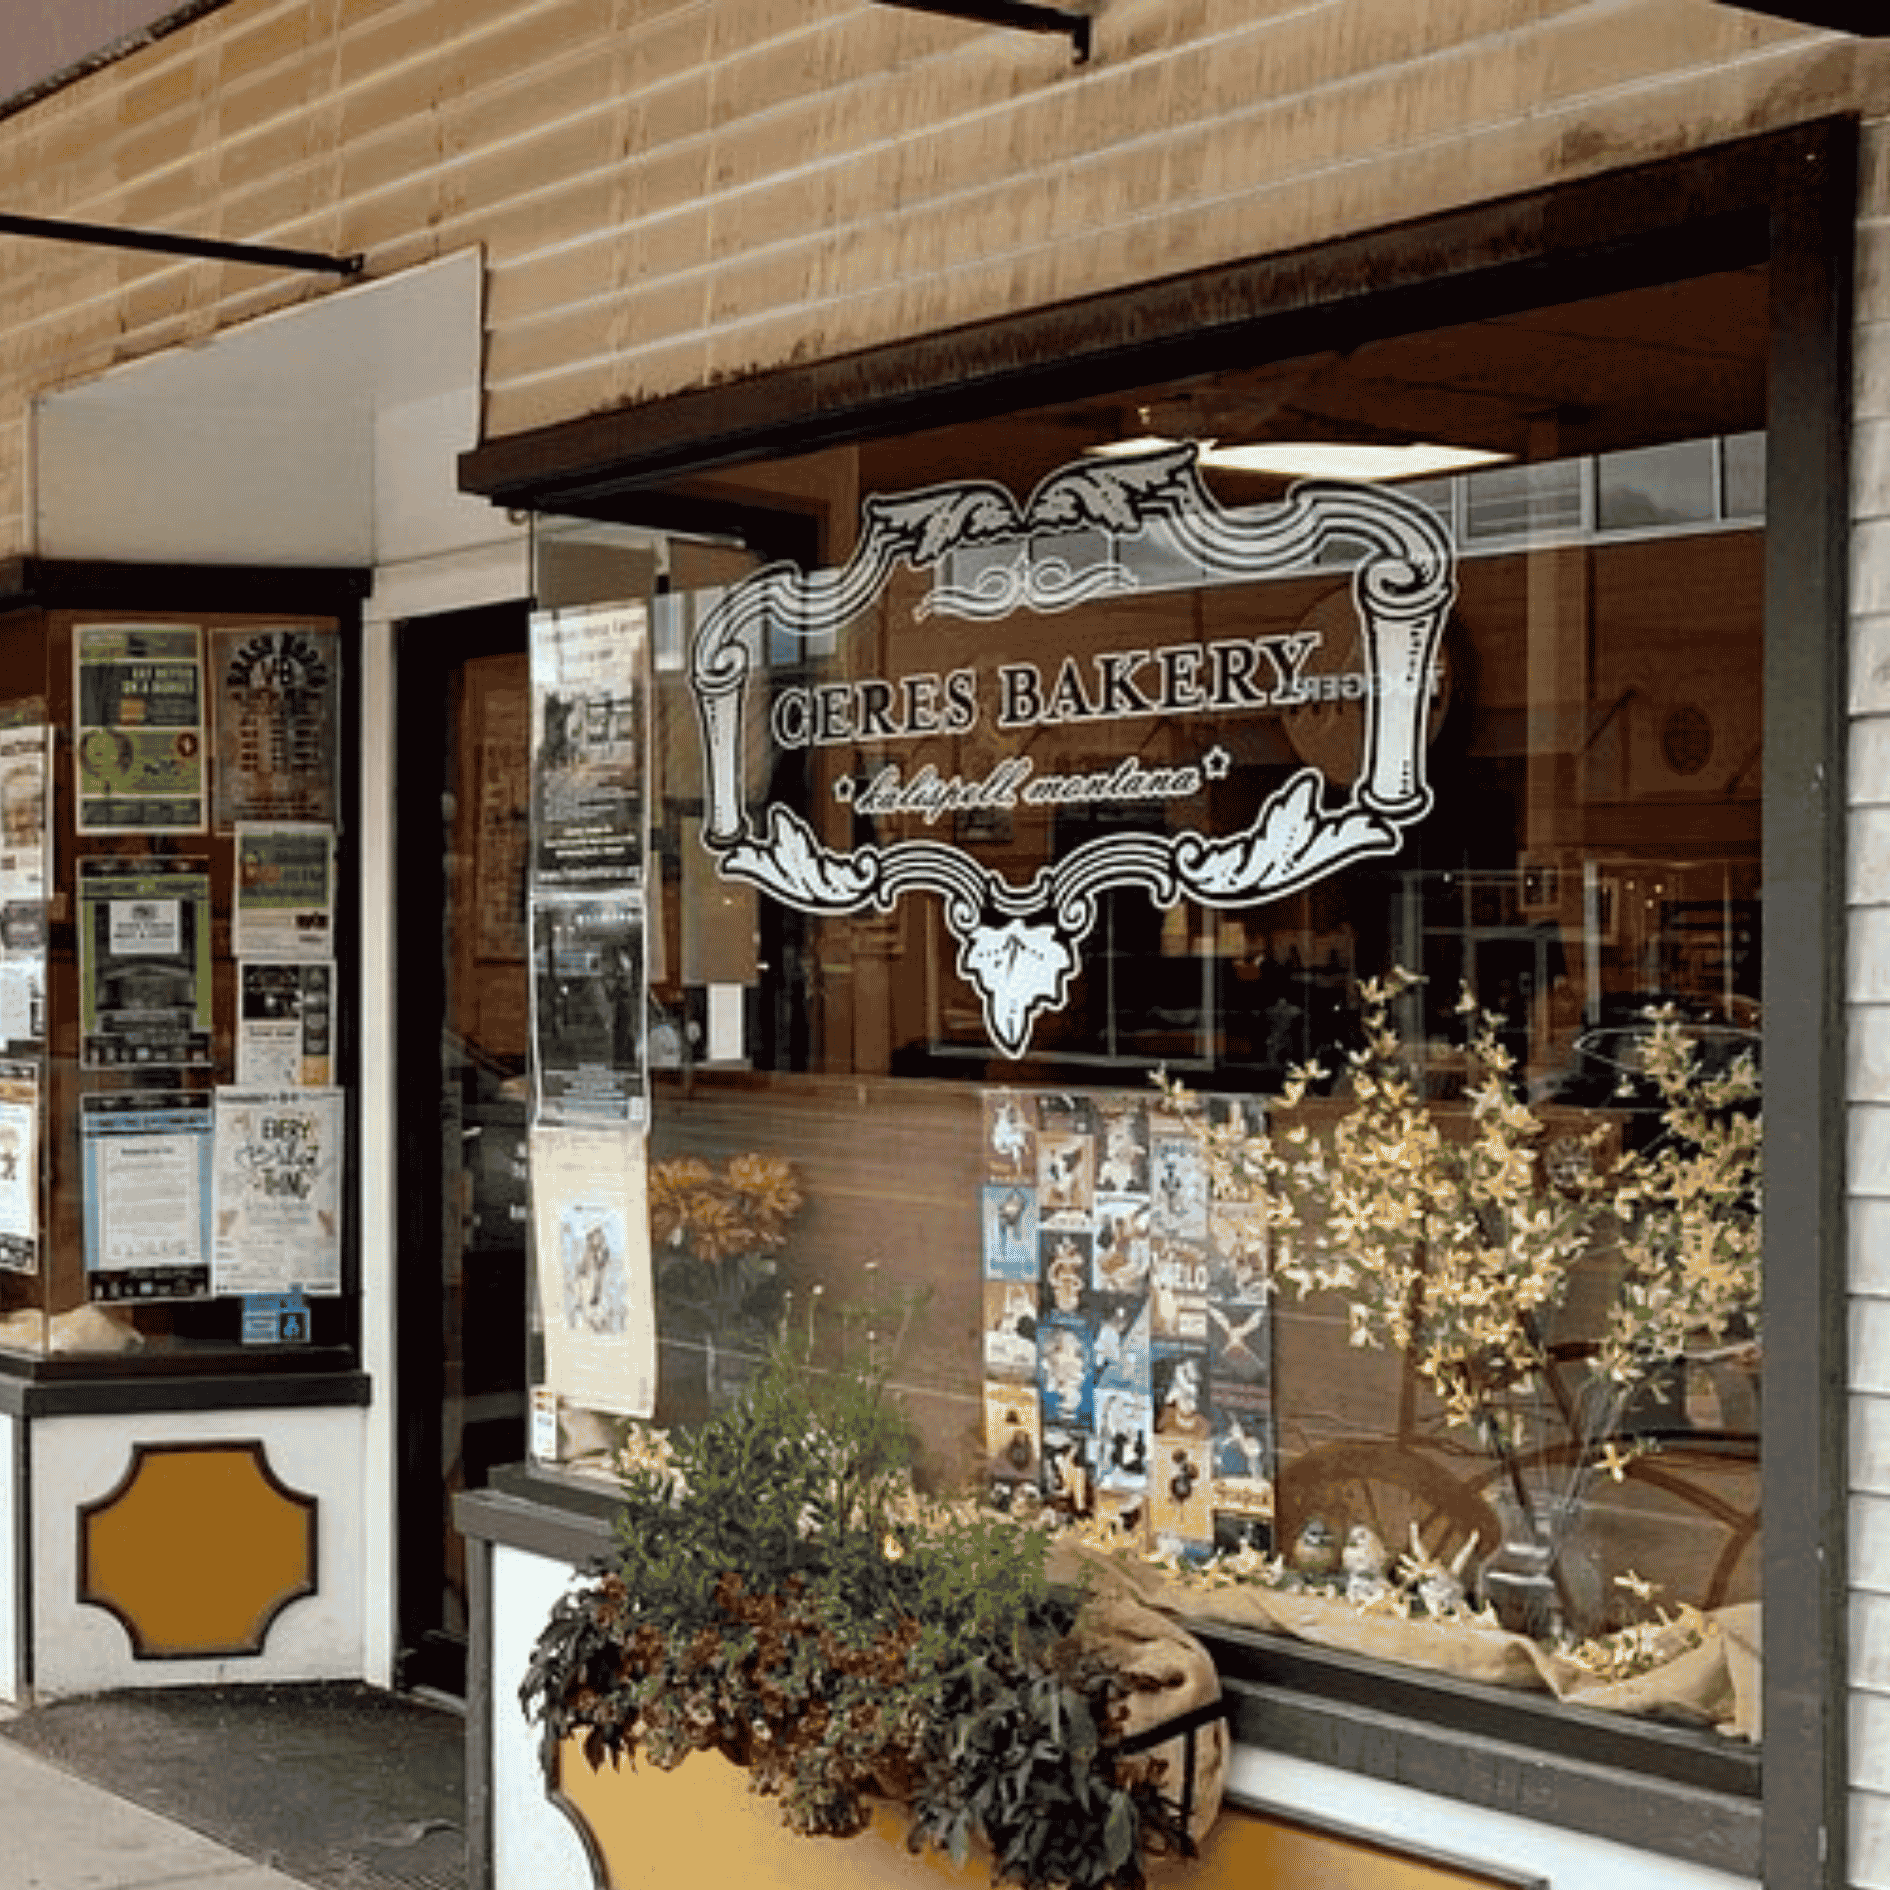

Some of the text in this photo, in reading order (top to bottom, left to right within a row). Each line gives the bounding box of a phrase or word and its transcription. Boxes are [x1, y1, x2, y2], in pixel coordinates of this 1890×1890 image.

[771, 631, 1323, 749] CERES BAKERY
[854, 755, 1201, 825] kalispell montana
